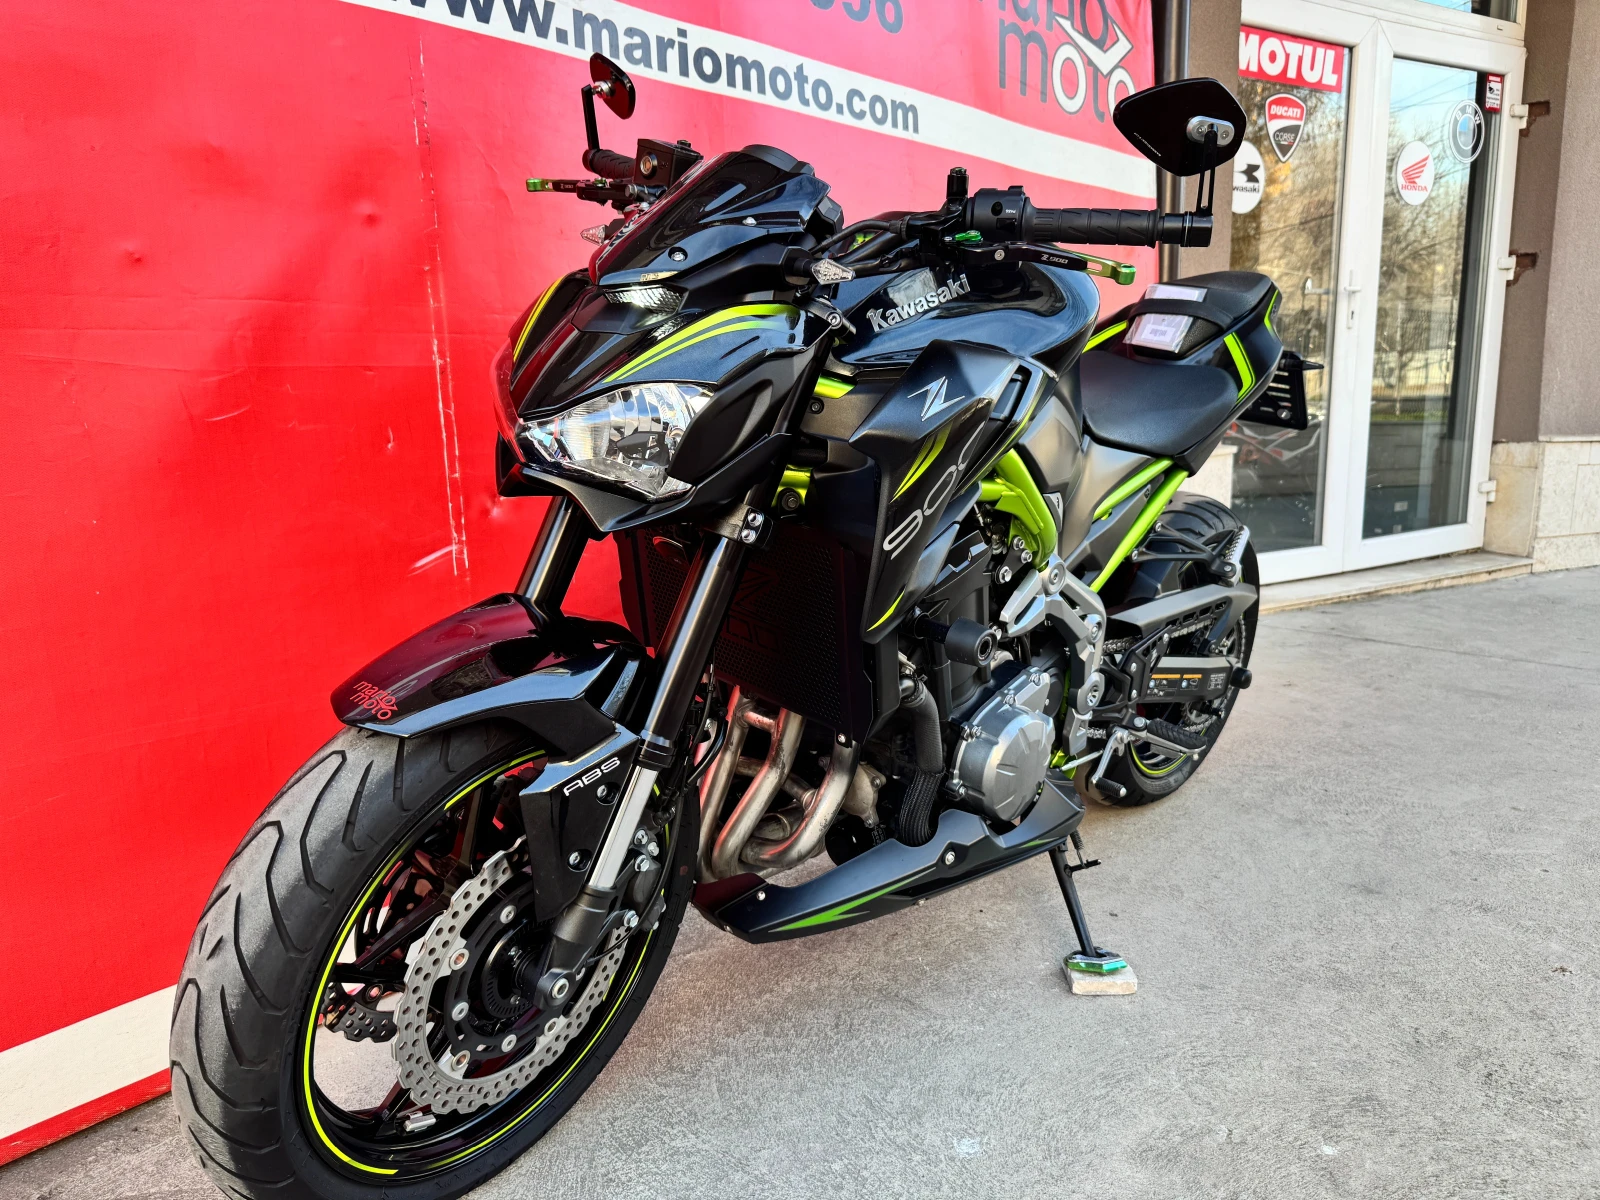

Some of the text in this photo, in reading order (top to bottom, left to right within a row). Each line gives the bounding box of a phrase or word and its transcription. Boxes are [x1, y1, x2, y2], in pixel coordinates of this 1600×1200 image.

[1239, 31, 1338, 86] MOTUL
[1270, 104, 1301, 118] DUCATI
[1455, 105, 1481, 125] BMW
[1233, 185, 1260, 194] wasaki
[1401, 184, 1428, 192] HONDA
[866, 273, 970, 333] Kawasaki
[353, 681, 396, 706] mario
[563, 756, 621, 797] ABS
